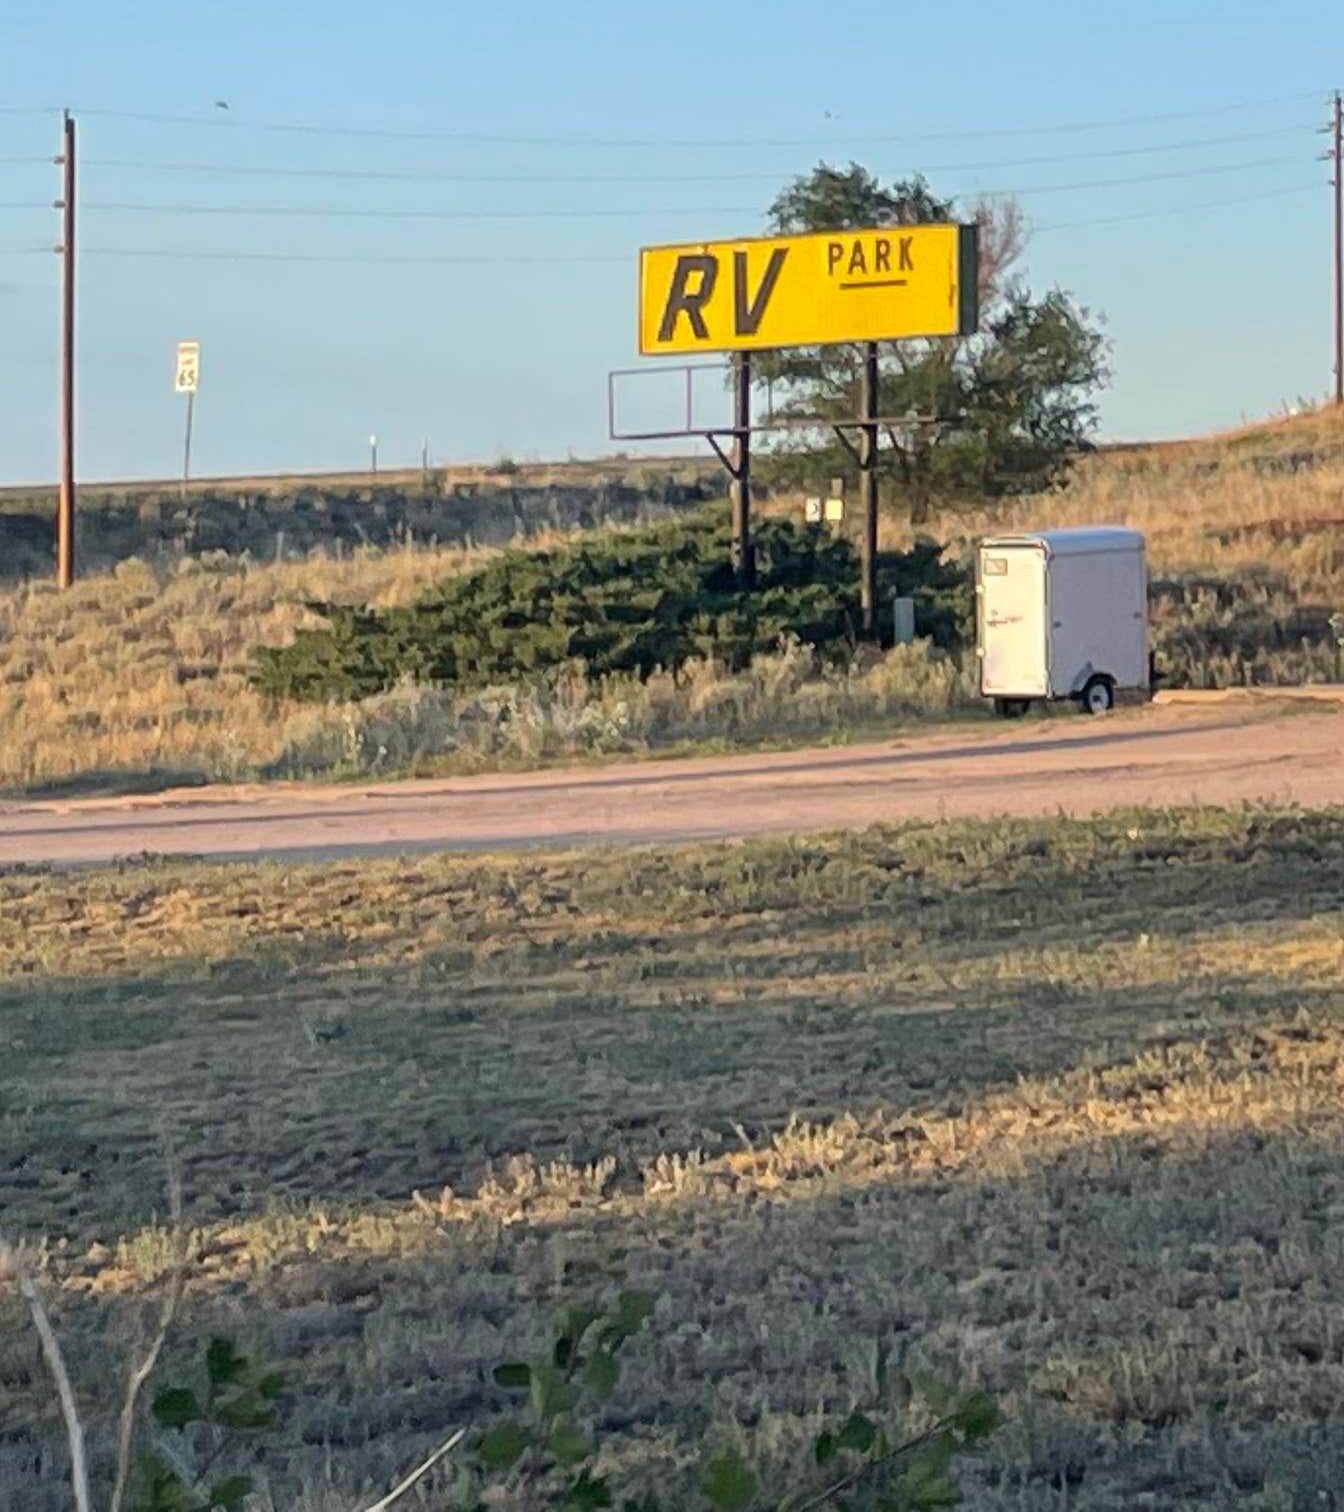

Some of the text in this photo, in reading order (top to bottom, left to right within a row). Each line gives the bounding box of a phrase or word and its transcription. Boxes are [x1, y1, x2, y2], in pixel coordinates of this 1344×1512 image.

[657, 236, 915, 343] RV PARK
[179, 369, 195, 387] 65
